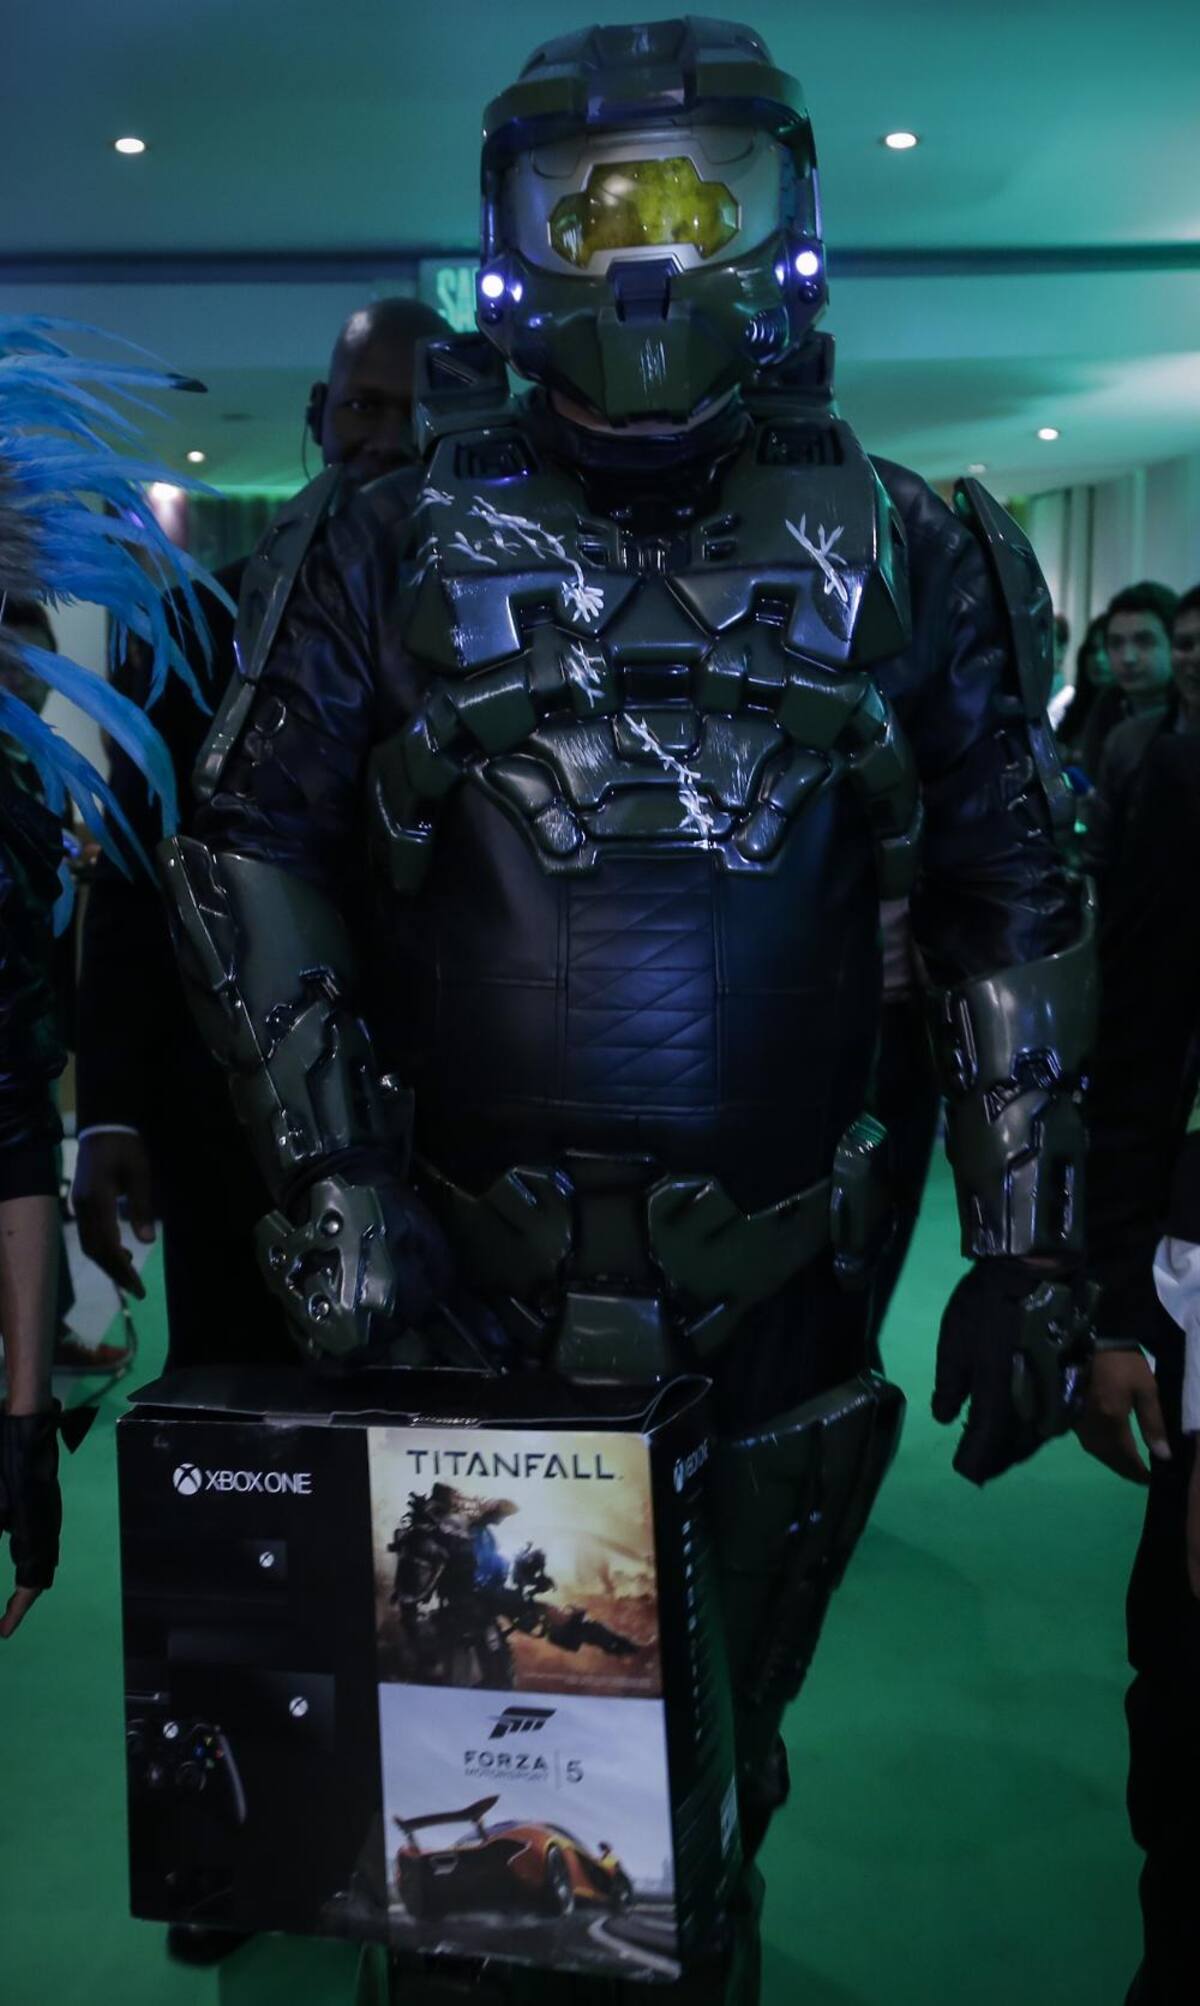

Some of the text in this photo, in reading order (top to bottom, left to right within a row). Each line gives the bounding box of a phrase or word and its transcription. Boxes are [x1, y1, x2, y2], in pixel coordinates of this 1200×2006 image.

[406, 1449, 615, 1480] TITANFALL
[464, 1750, 584, 1783] FORZA 5
